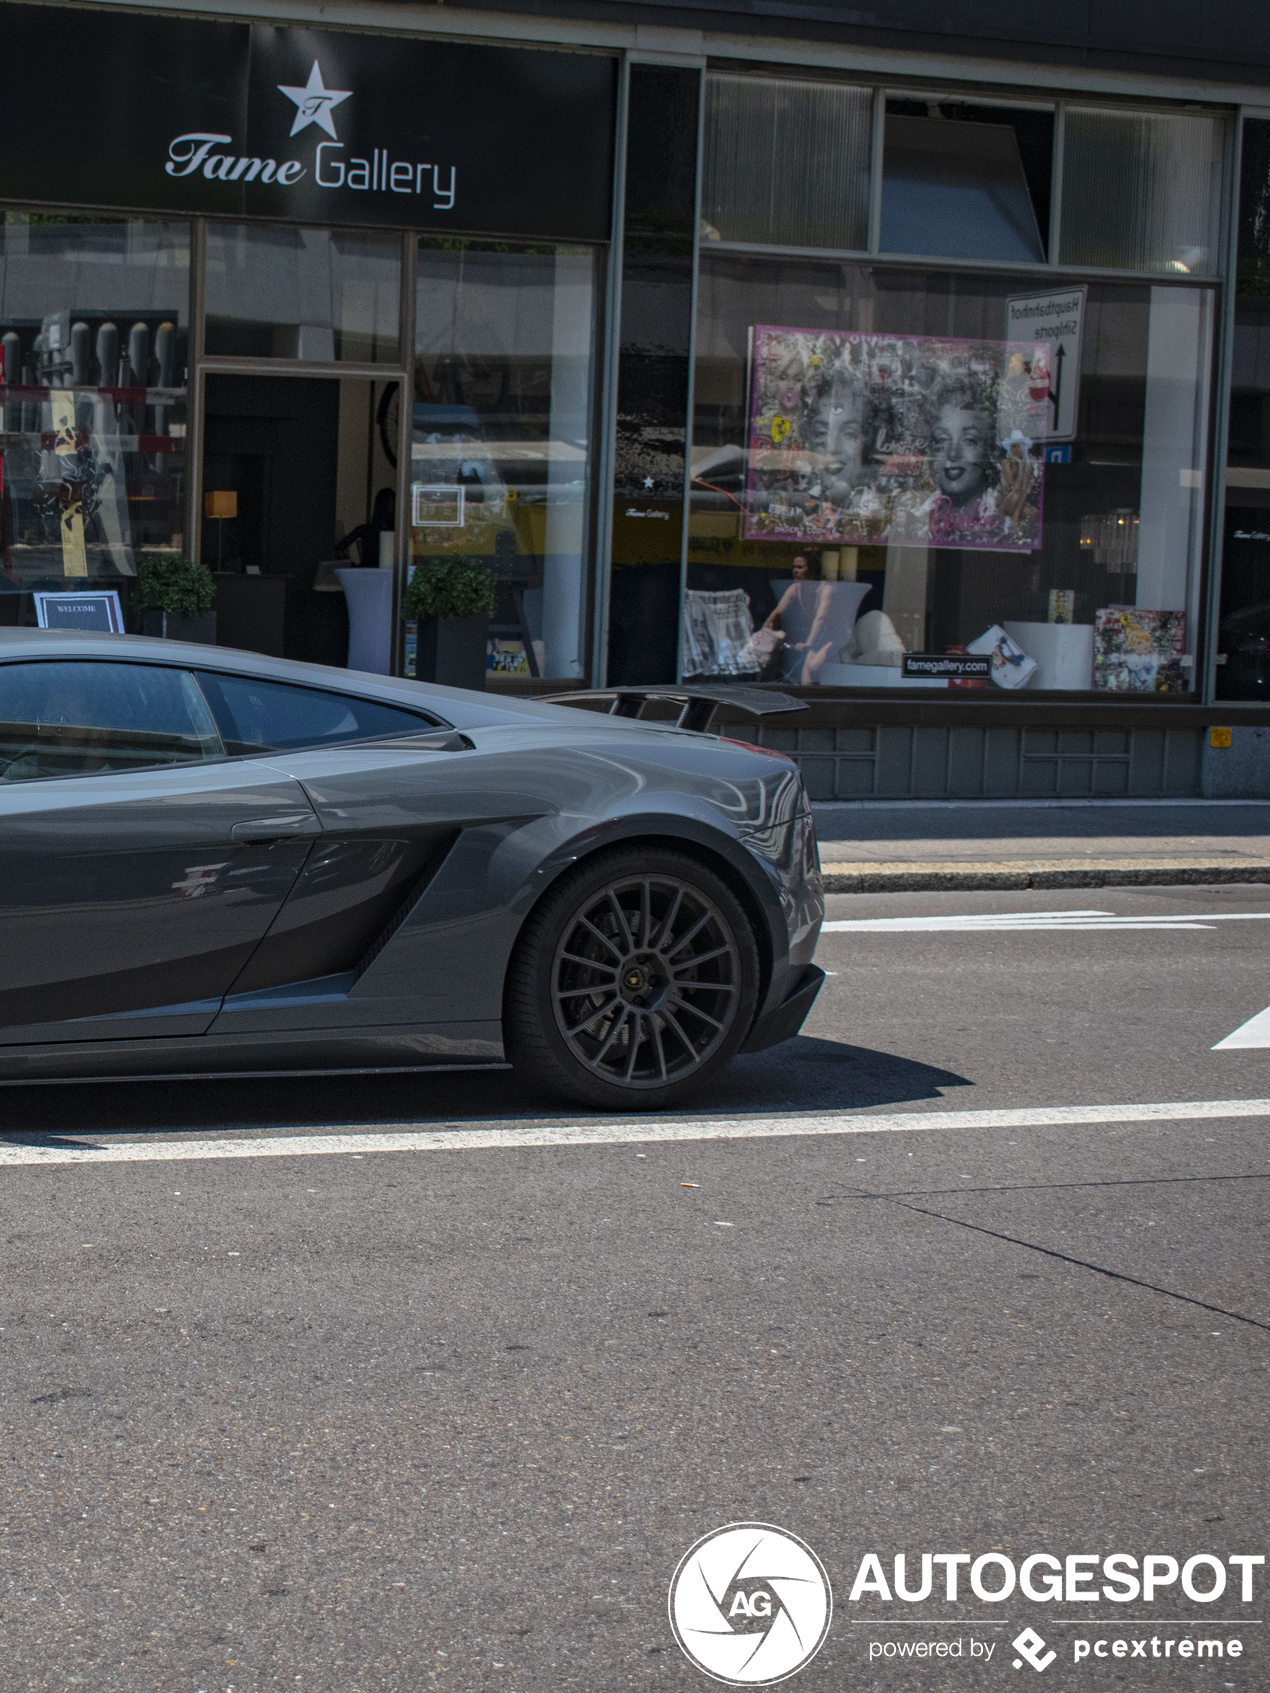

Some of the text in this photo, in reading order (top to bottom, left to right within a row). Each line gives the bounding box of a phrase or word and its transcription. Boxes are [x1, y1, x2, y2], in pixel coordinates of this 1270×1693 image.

[164, 132, 457, 210] Fame Gallery
[57, 605, 97, 613] WELCOME
[906, 658, 988, 674] famegallery.com
